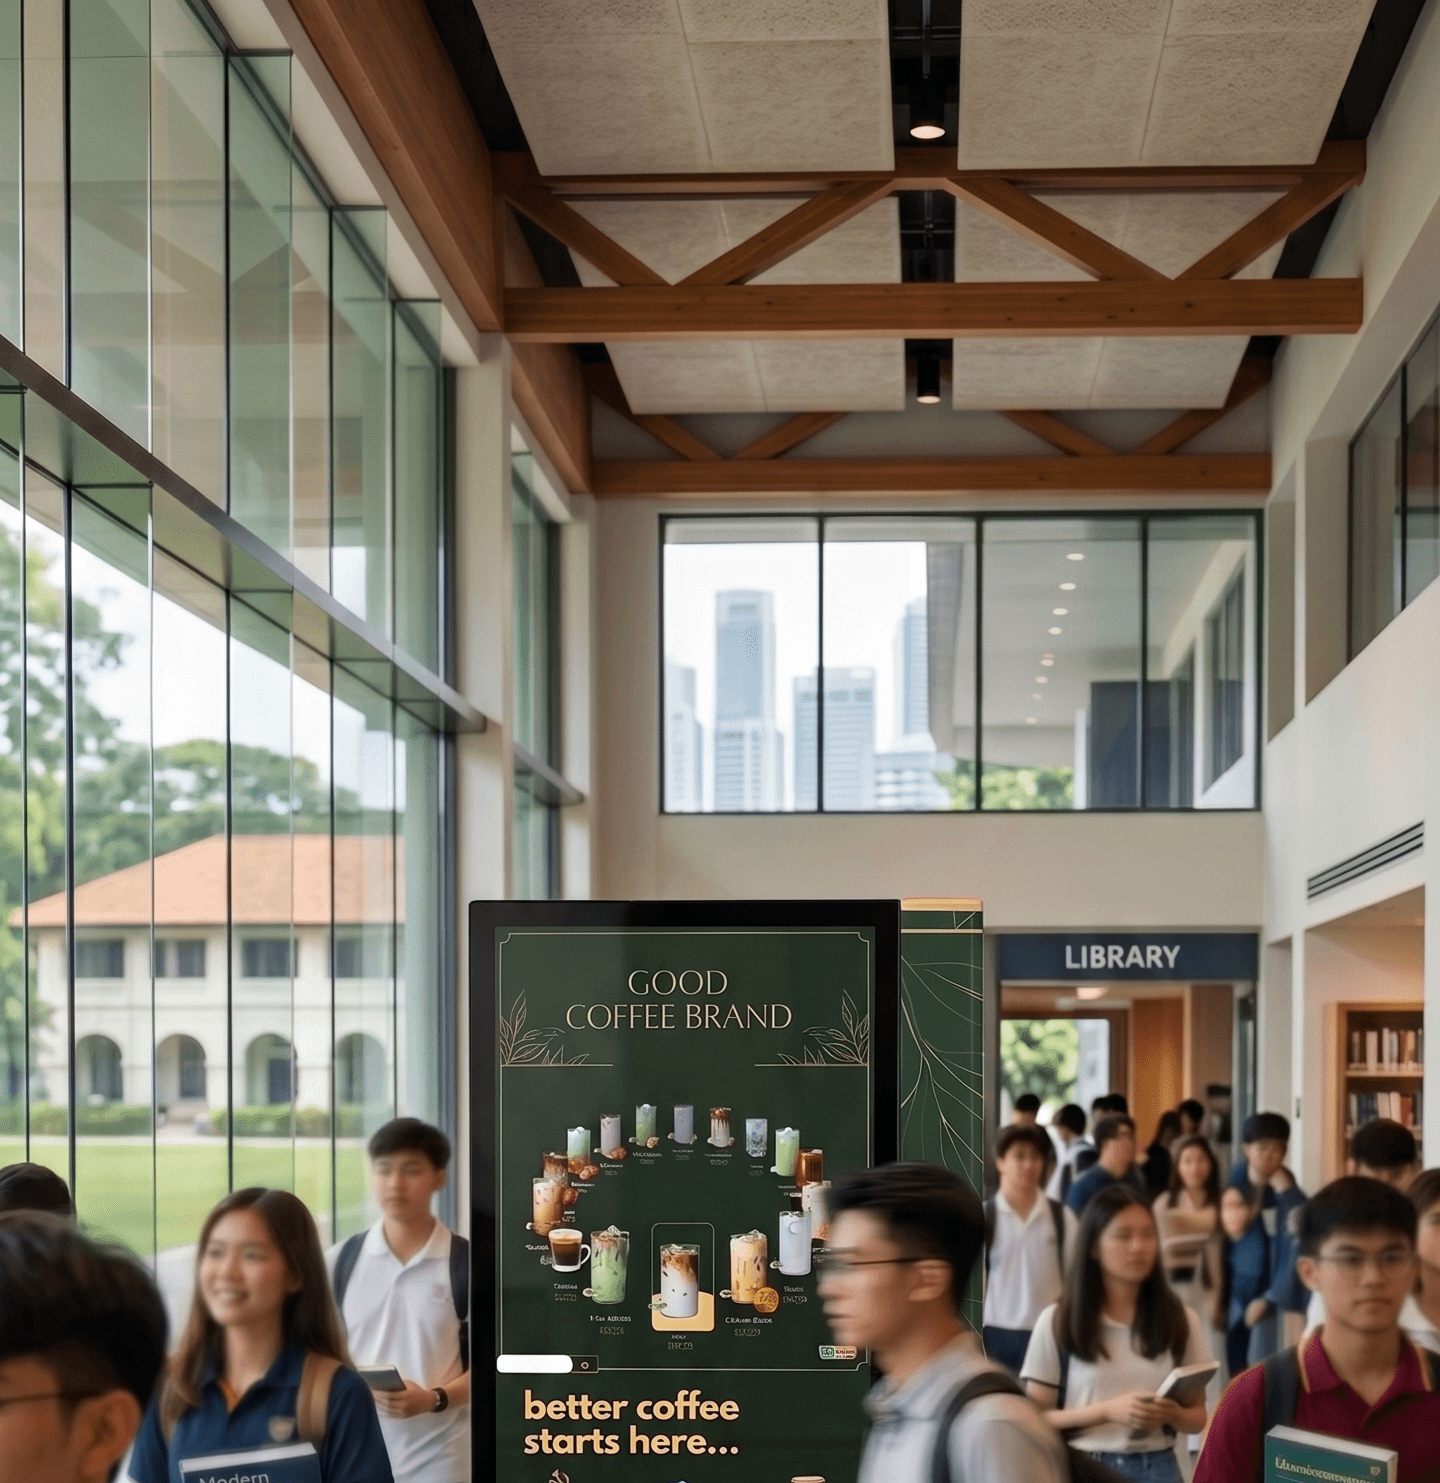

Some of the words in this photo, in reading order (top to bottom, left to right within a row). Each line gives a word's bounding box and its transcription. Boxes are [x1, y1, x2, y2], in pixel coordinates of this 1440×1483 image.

[1065, 944, 1181, 969] LIBRARY
[628, 970, 728, 996] GOOD
[566, 1004, 675, 1030] COFFEE
[686, 1004, 792, 1029] BRAND
[524, 1389, 628, 1420] better
[636, 1389, 740, 1421] coffee
[523, 1428, 620, 1455] starts
[629, 1425, 739, 1455] here...
